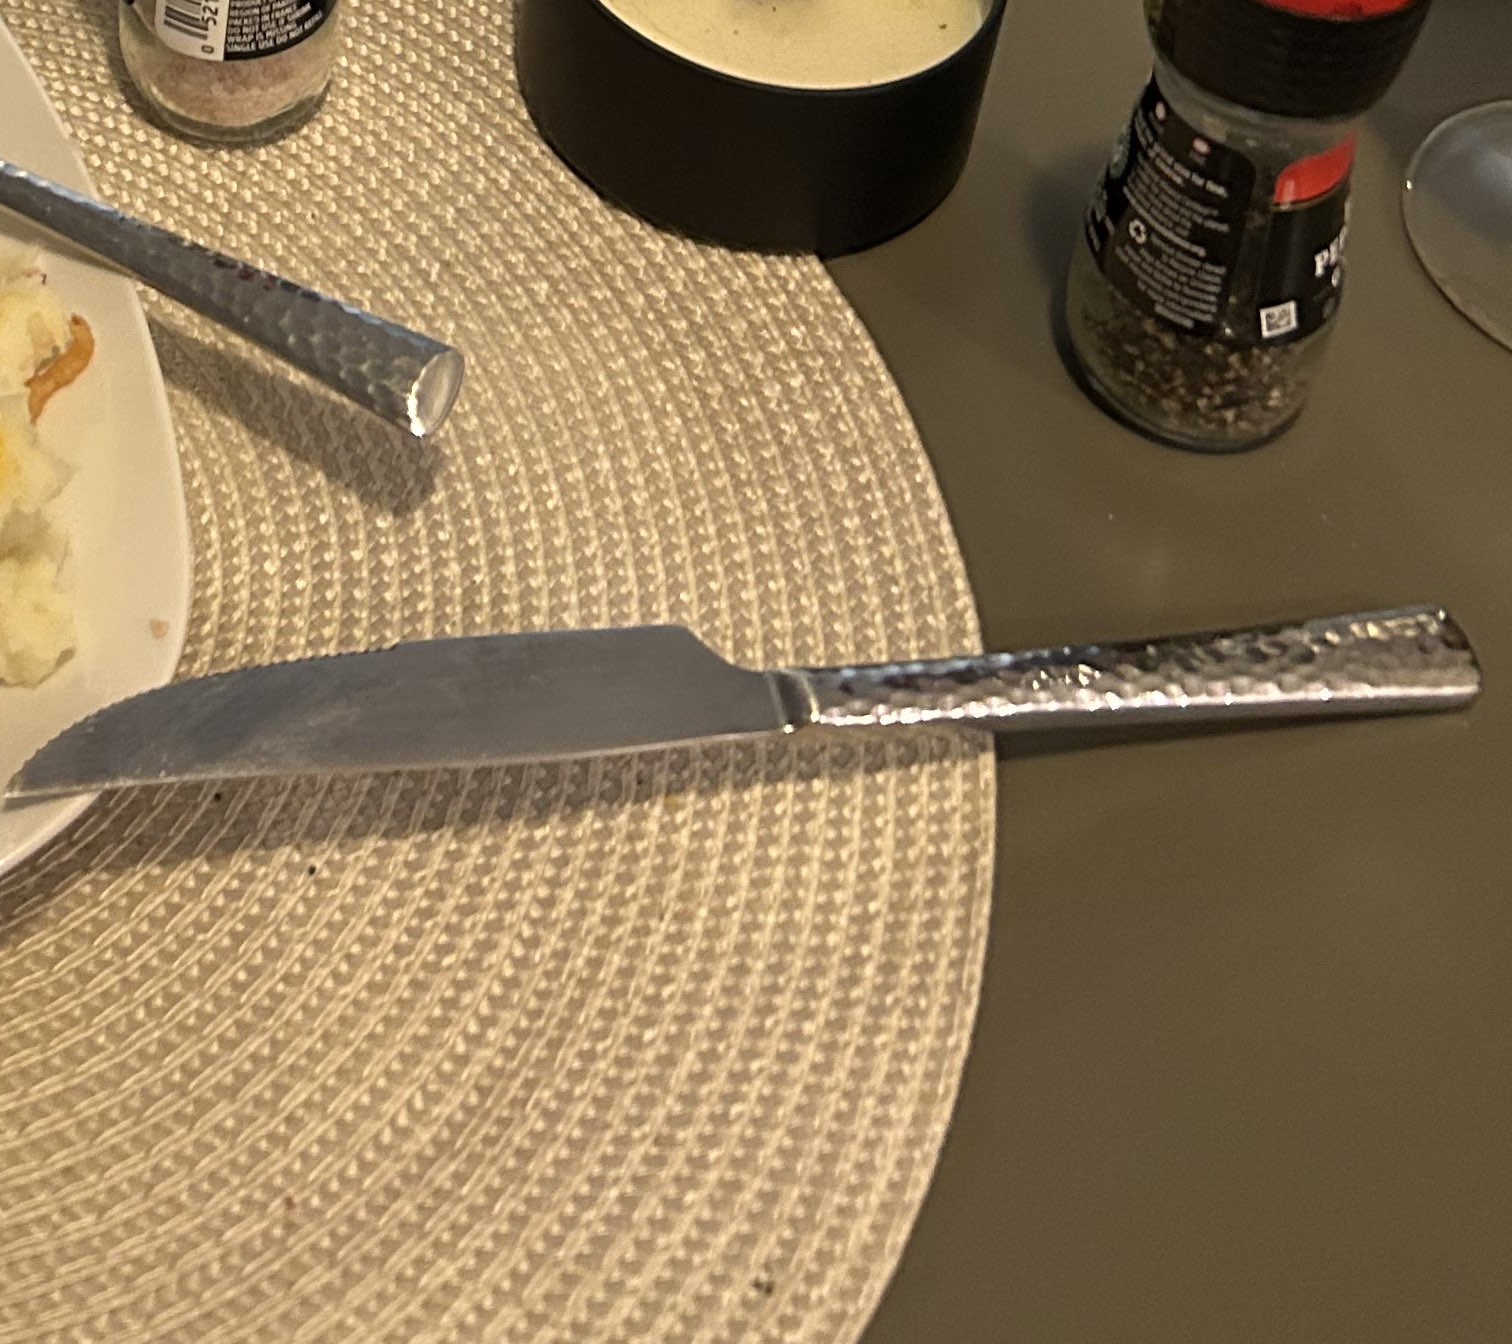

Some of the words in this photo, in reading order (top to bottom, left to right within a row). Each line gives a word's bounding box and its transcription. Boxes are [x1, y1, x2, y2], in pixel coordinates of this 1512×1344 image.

[227, 33, 255, 44] WRAP
[200, 44, 215, 54] 0
[257, 39, 275, 50] USE
